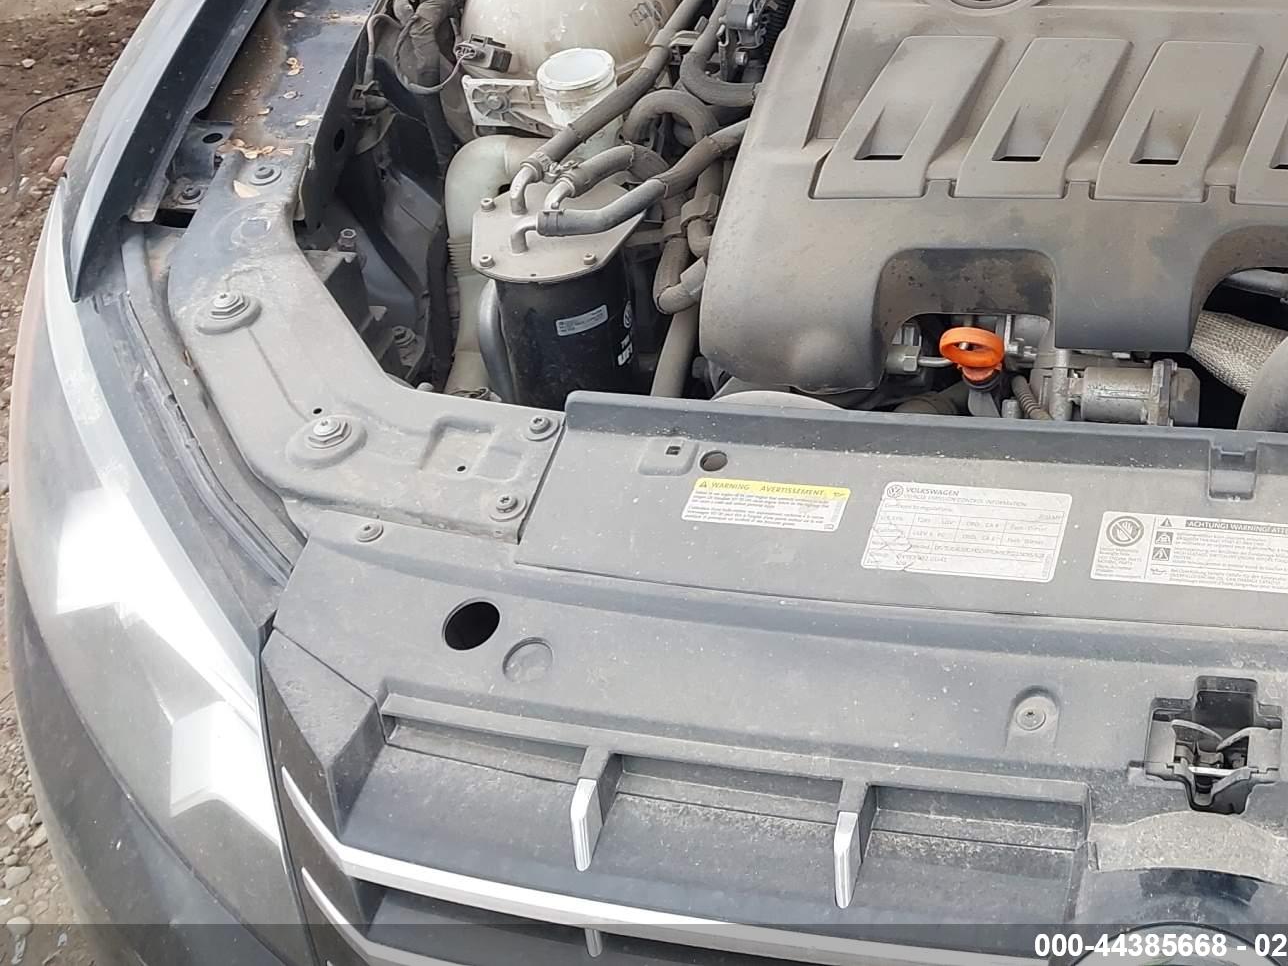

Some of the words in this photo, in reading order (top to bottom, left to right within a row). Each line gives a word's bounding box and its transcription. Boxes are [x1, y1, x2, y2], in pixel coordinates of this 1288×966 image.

[711, 481, 750, 491] WARNING
[761, 485, 825, 497] AVERTISSEMENT
[906, 487, 960, 497] VOLKSWAGEN
